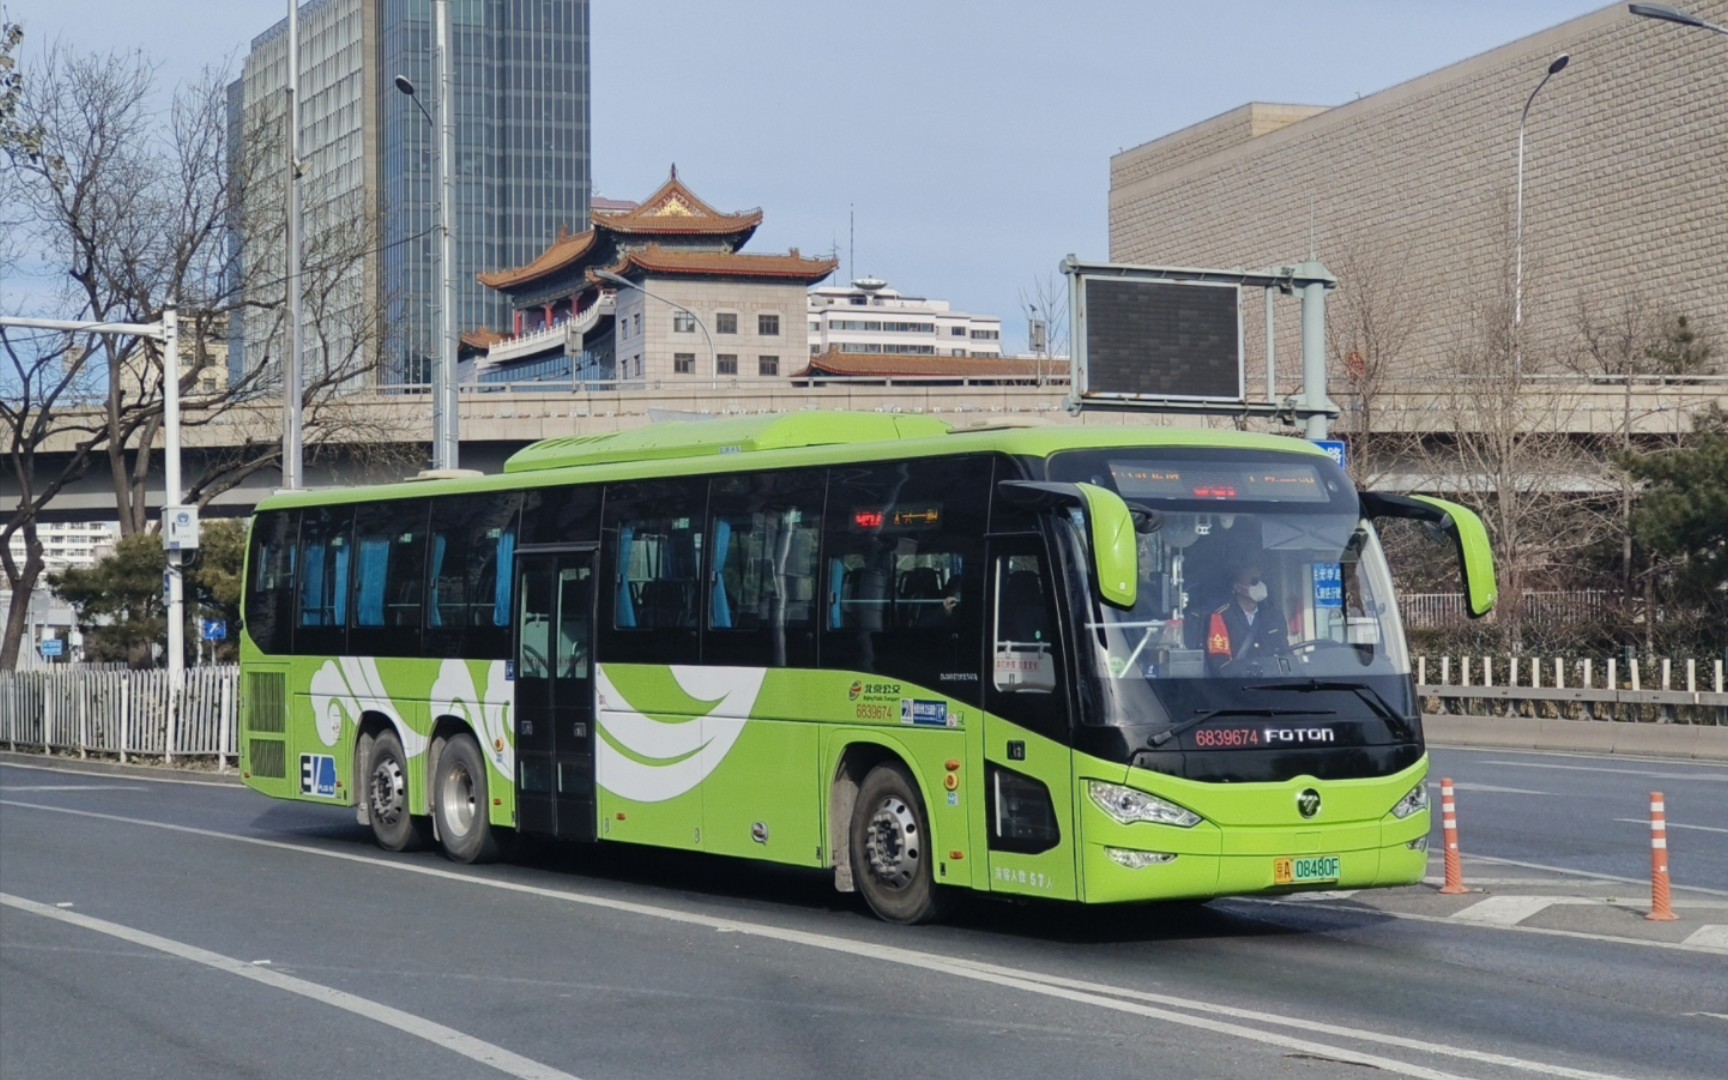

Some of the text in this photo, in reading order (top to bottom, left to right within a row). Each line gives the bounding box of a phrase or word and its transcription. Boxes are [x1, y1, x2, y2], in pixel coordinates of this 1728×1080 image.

[864, 683, 901, 694] 北京公交
[856, 703, 893, 720] 6839674
[1195, 729, 1258, 746] 6839674
[1264, 727, 1335, 744] FOTON
[300, 755, 322, 794] EV
[1296, 857, 1339, 878] 08480F
